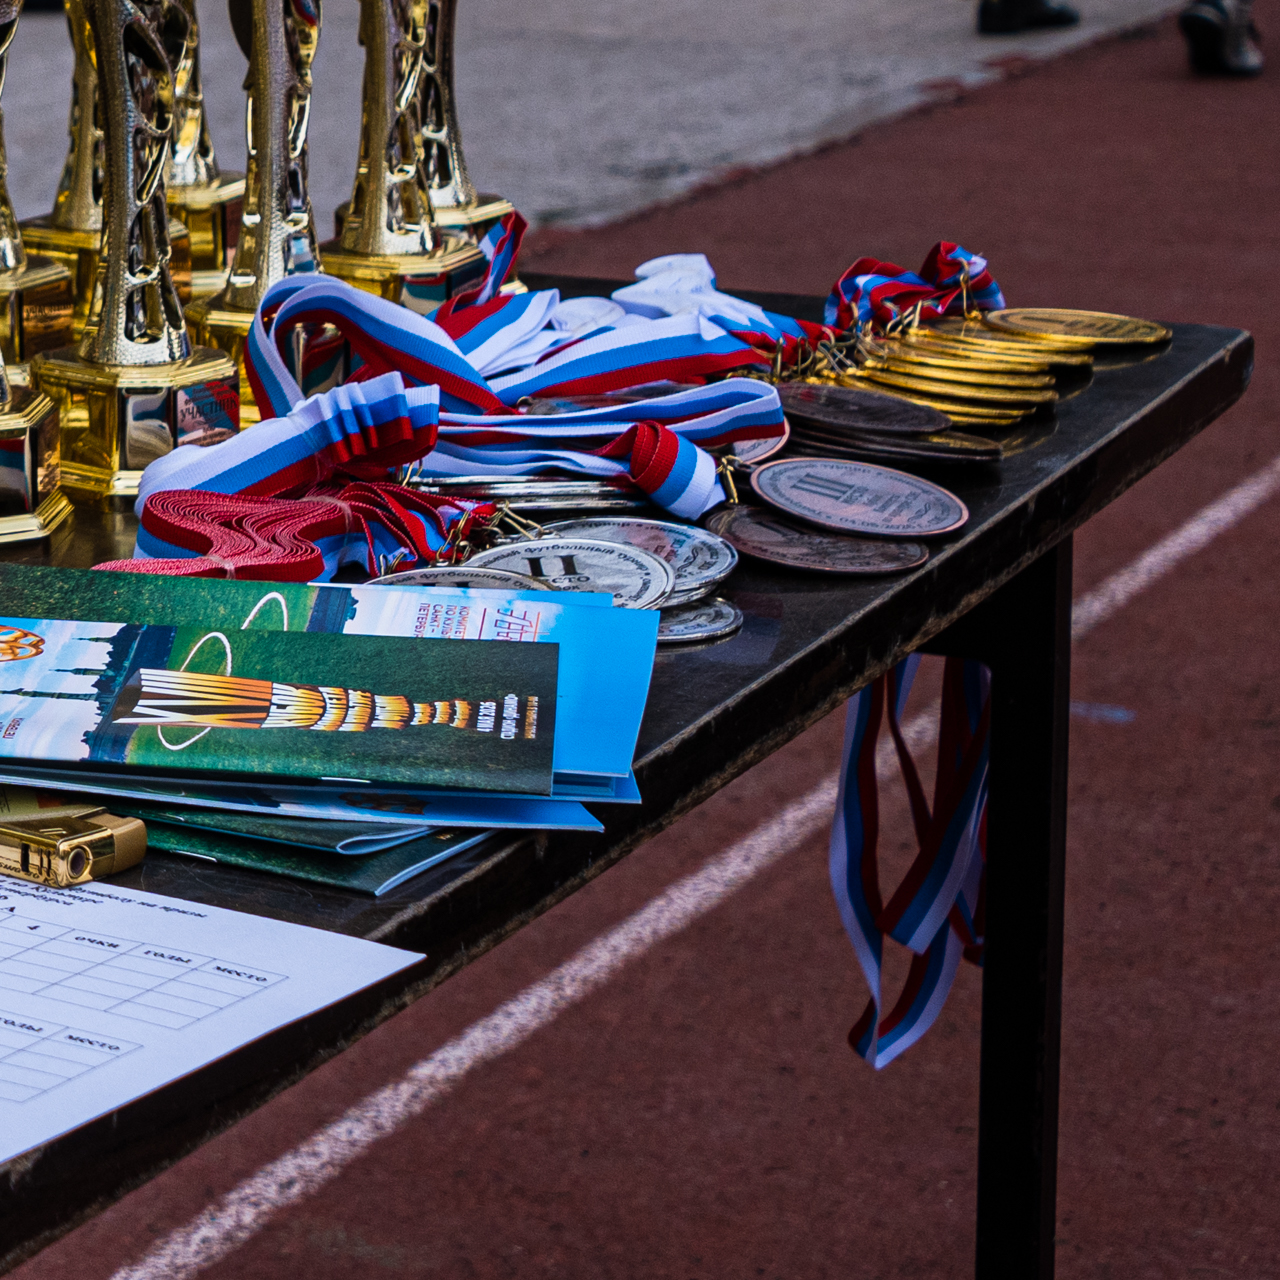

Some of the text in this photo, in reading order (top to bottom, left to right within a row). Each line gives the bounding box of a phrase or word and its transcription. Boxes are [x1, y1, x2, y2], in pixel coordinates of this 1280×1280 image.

[522, 554, 585, 578] II
[446, 605, 457, 615] ПО
[113, 667, 272, 729] XVIII
[260, 682, 326, 728] КУБОК
[74, 935, 121, 949] очки
[143, 949, 193, 964] голы
[215, 965, 268, 983] место
[66, 1034, 121, 1051] место
